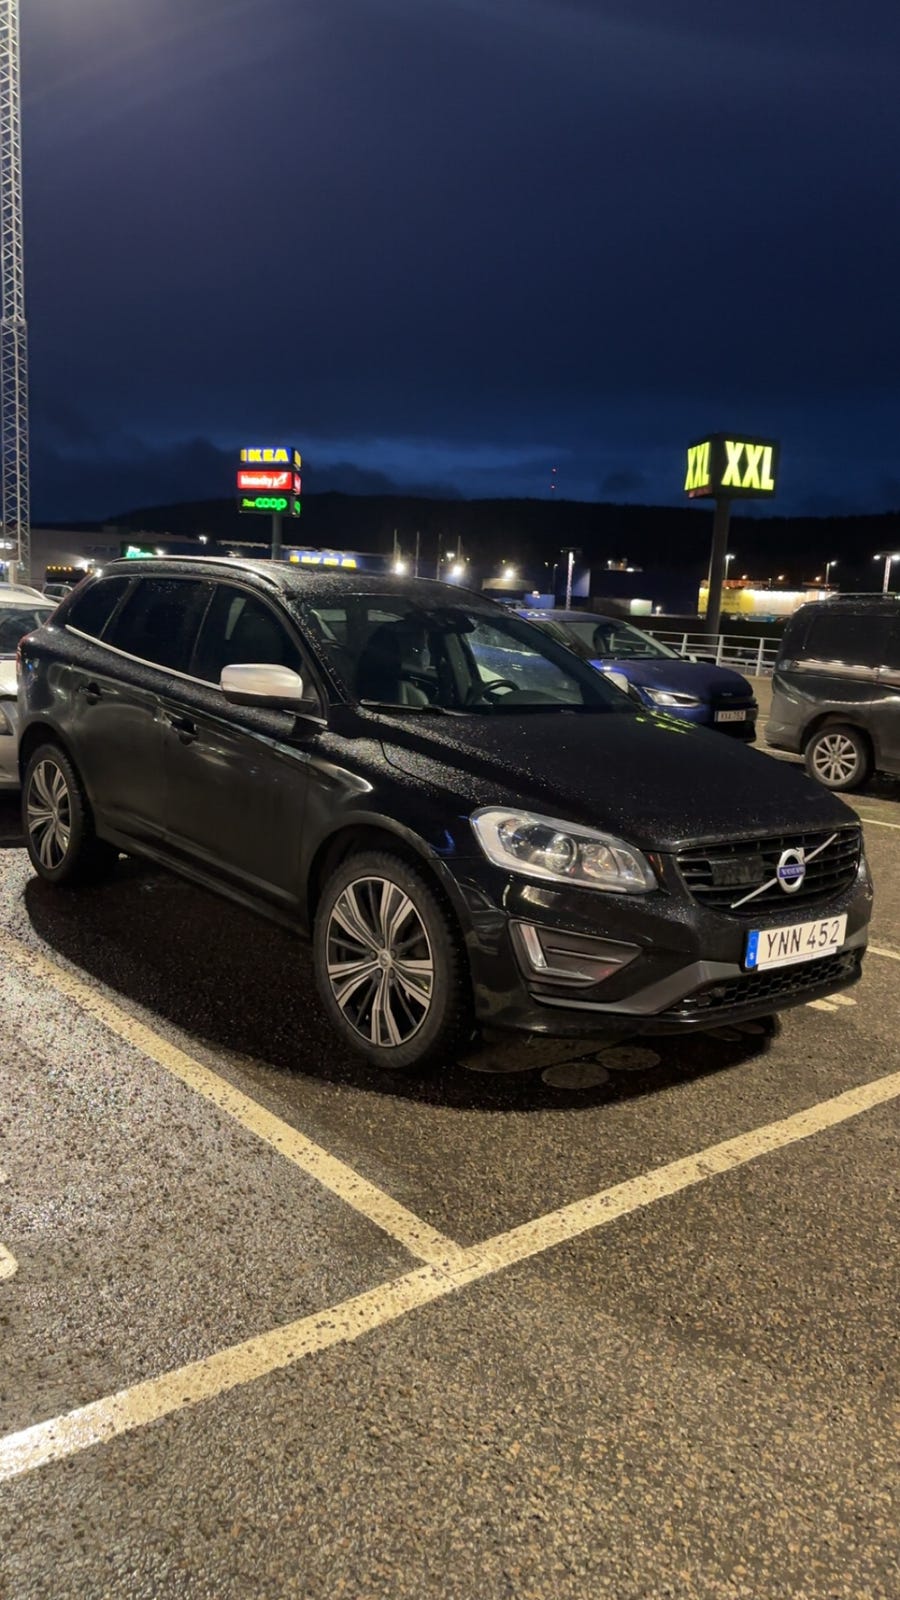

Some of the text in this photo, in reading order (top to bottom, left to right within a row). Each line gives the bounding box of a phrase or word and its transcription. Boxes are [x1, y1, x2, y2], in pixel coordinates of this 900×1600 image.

[240, 448, 289, 462] IKEA
[684, 441, 710, 491] XXL
[721, 440, 774, 490] XXL
[767, 927, 803, 958] YNN
[807, 920, 840, 949] 452
